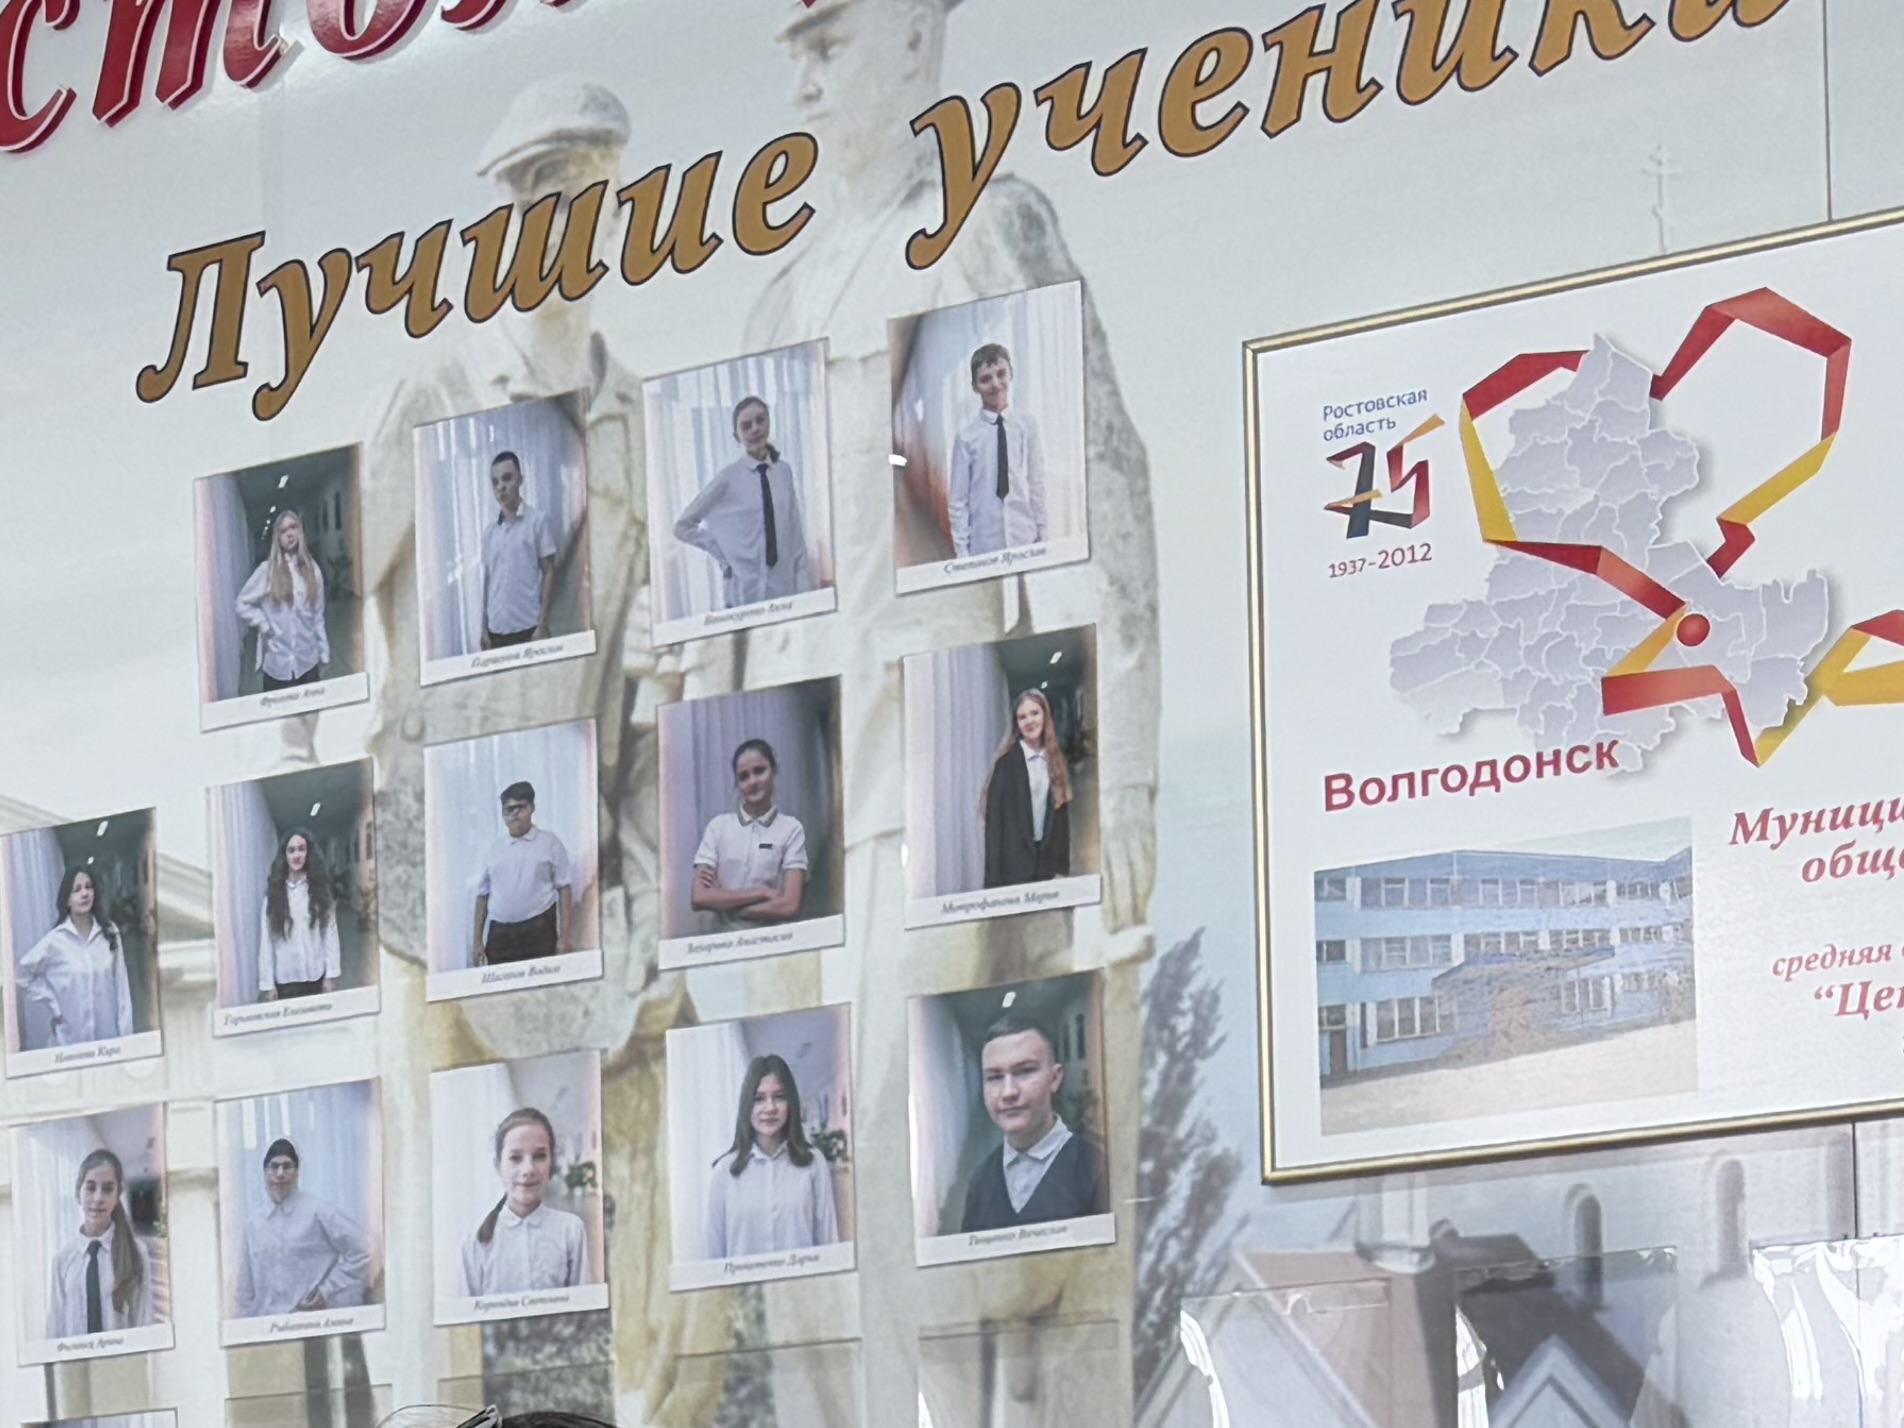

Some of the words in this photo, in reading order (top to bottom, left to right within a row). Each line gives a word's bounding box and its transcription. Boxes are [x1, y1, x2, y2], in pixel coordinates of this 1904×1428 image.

[135, 131, 818, 421] Лучшие
[1323, 389, 1428, 421] Ростовская
[1323, 417, 1397, 441] область
[1328, 542, 1433, 579] 1937-2012
[1324, 740, 1620, 812] Волгодонск
[1801, 838, 1904, 882] общ
[1772, 942, 1893, 983] средняя
